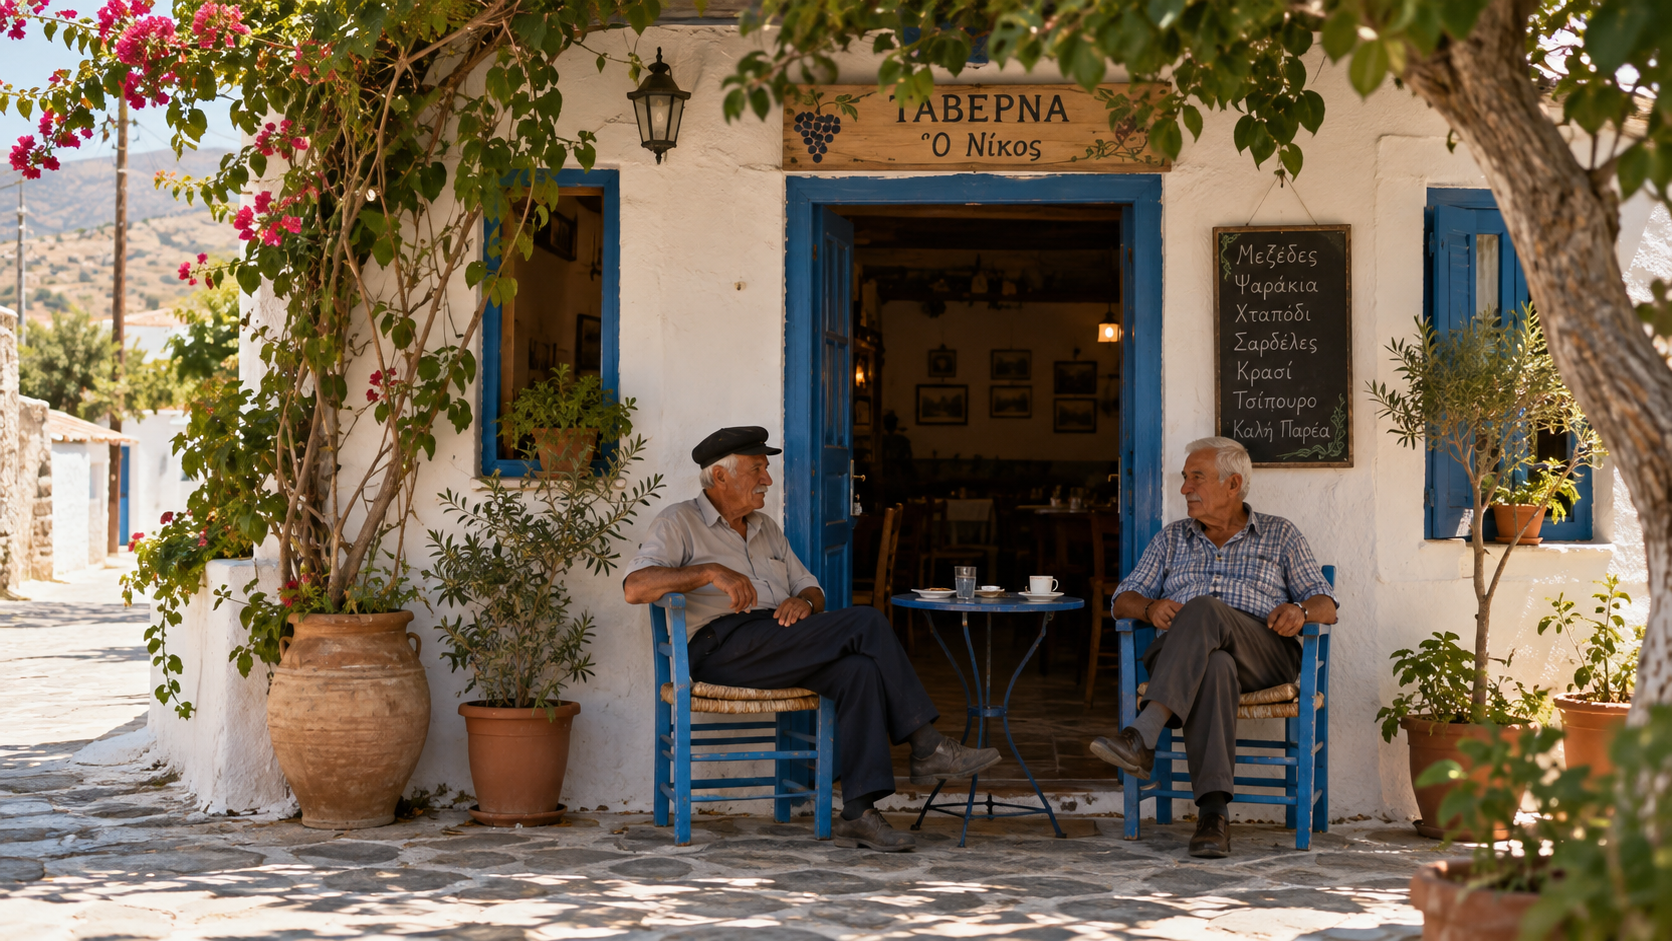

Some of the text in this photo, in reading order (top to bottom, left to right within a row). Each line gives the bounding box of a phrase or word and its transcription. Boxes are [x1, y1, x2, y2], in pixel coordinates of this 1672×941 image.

[965, 132, 1042, 161] Νίκος
[1236, 244, 1318, 269] Μεζέδες
[1235, 274, 1318, 300] Ψαράκια
[1235, 303, 1311, 323] Χταπόδι
[1233, 332, 1318, 357] Σαρδέλες
[1237, 361, 1292, 387] Κρασί
[1232, 390, 1317, 415] Τσίπουρο
[1233, 420, 1331, 444] Καλή Παρέα
